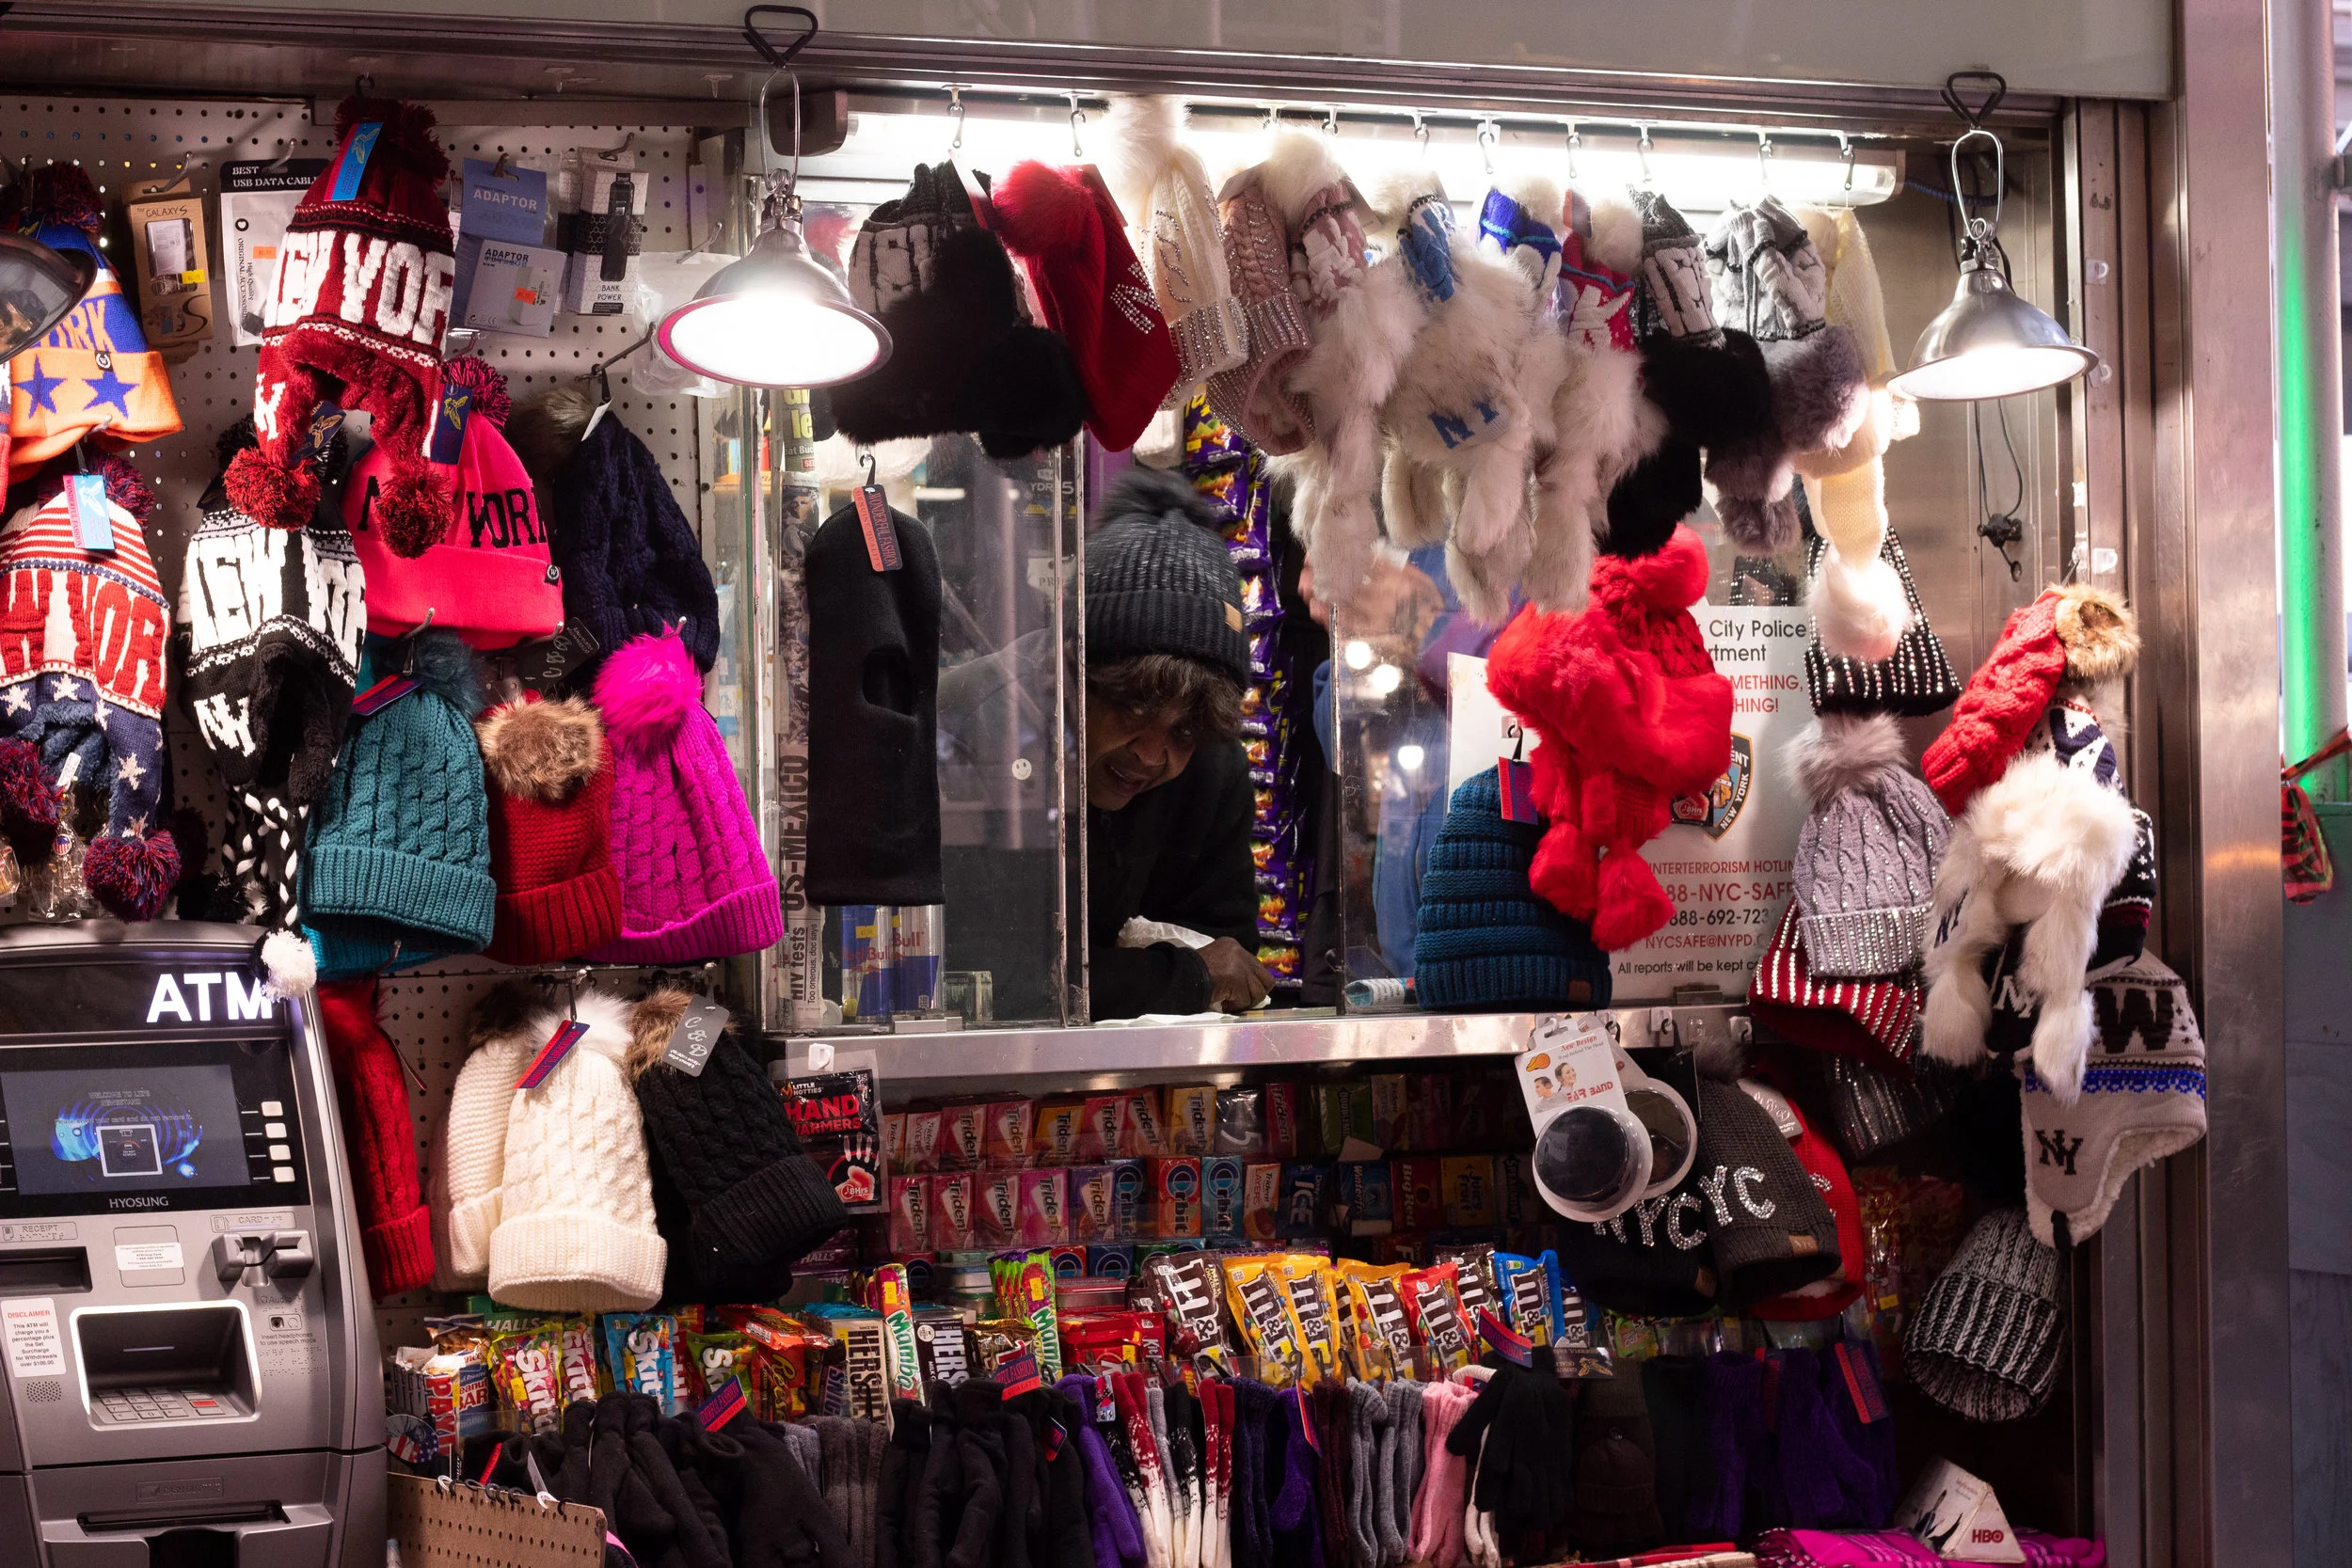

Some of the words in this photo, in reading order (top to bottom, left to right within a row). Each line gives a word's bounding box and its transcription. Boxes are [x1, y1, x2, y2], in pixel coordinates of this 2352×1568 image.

[232, 166, 259, 175] BEST
[233, 178, 253, 187] USB
[255, 177, 285, 187] DATA
[287, 176, 316, 185] CABL
[146, 208, 178, 217] GALAXY
[179, 205, 188, 216] S
[473, 188, 537, 211] ADAPTOR
[237, 237, 246, 274] ORIGINAL
[485, 247, 529, 261] ADAPTOR
[246, 261, 254, 277] High
[238, 275, 247, 318] ACCESSORI
[246, 277, 255, 300] Quality
[341, 232, 455, 355] YOR
[596, 293, 622, 301] POWER
[601, 284, 620, 293] BANK
[800, 445, 814, 454] Buc
[66, 478, 77, 517] WONDERFUL
[73, 518, 84, 548] FASHION
[467, 485, 548, 548] YOR
[855, 489, 869, 525] GENUINE
[867, 529, 883, 567] QUALITY
[868, 491, 886, 538] WONDERFUL
[881, 535, 898, 567] FASHION
[1709, 619, 1744, 641] City
[1752, 619, 1807, 638] Police
[1708, 644, 1766, 661] rtment
[1730, 674, 1804, 692] METHING,
[1734, 698, 1779, 713] HING!
[1731, 751, 1750, 768] ENT
[1720, 806, 1738, 830] NEW
[1734, 773, 1749, 802] YORK
[1651, 861, 1750, 876] NTERTERRORISM
[1754, 860, 1794, 873] HOTLIN
[1669, 909, 1770, 927] 888-692-723
[810, 923, 819, 939] says
[893, 931, 921, 947] Bull
[1646, 934, 1767, 949] NYCSAFE@NYPD.
[791, 927, 805, 965] tests
[809, 940, 818, 954] doc
[866, 945, 891, 961] Bull
[808, 956, 818, 989] onerous,
[1617, 963, 1631, 974] All
[1634, 962, 1673, 975] reports
[1676, 960, 1693, 972] will
[1697, 960, 1712, 972] be
[1716, 959, 1743, 974] kept
[146, 971, 274, 1023] ATM
[790, 973, 804, 1001] HIV
[807, 990, 817, 1005] Too
[1560, 1042, 1574, 1052] New
[1575, 1035, 1597, 1046] Design
[792, 1082, 816, 1090] LITTLE
[793, 1087, 823, 1096] HOTTIES
[1565, 1087, 1587, 1102] EAR
[1588, 1080, 1613, 1095] BAND
[785, 1093, 860, 1122] HAND
[1130, 1093, 1159, 1145] Trident
[1271, 1087, 1291, 1144] Trident
[1101, 1101, 1118, 1157] Trident
[1188, 1091, 1207, 1150] Trident
[889, 1122, 898, 1152] Trident
[960, 1110, 979, 1169] Trident
[1005, 1105, 1026, 1162] Trident
[1056, 1110, 1072, 1159] Trident
[2036, 1129, 2084, 1176] NY
[108, 1196, 169, 1210] HYOSUNG
[947, 1178, 968, 1234] Trident
[992, 1175, 1016, 1235] Trident
[1038, 1174, 1062, 1233] Trident
[1087, 1173, 1107, 1229] Trident
[1697, 1165, 1776, 1226] YC
[238, 1214, 263, 1224] CARD
[907, 1180, 926, 1243] Trident
[22, 1223, 58, 1233] RECEIPT
[801, 1251, 835, 1264] HALLS
[8, 1310, 51, 1319] DISCLAIMER
[485, 1317, 541, 1333] HALLS
[885, 1310, 920, 1390] Mamba
[932, 1328, 970, 1387] HERS
[516, 1349, 559, 1433] Skitt
[771, 1353, 798, 1421] Reese
[824, 1366, 845, 1415] SNIC
[459, 1388, 488, 1411] BAR
[1972, 1529, 2004, 1543] HBO
